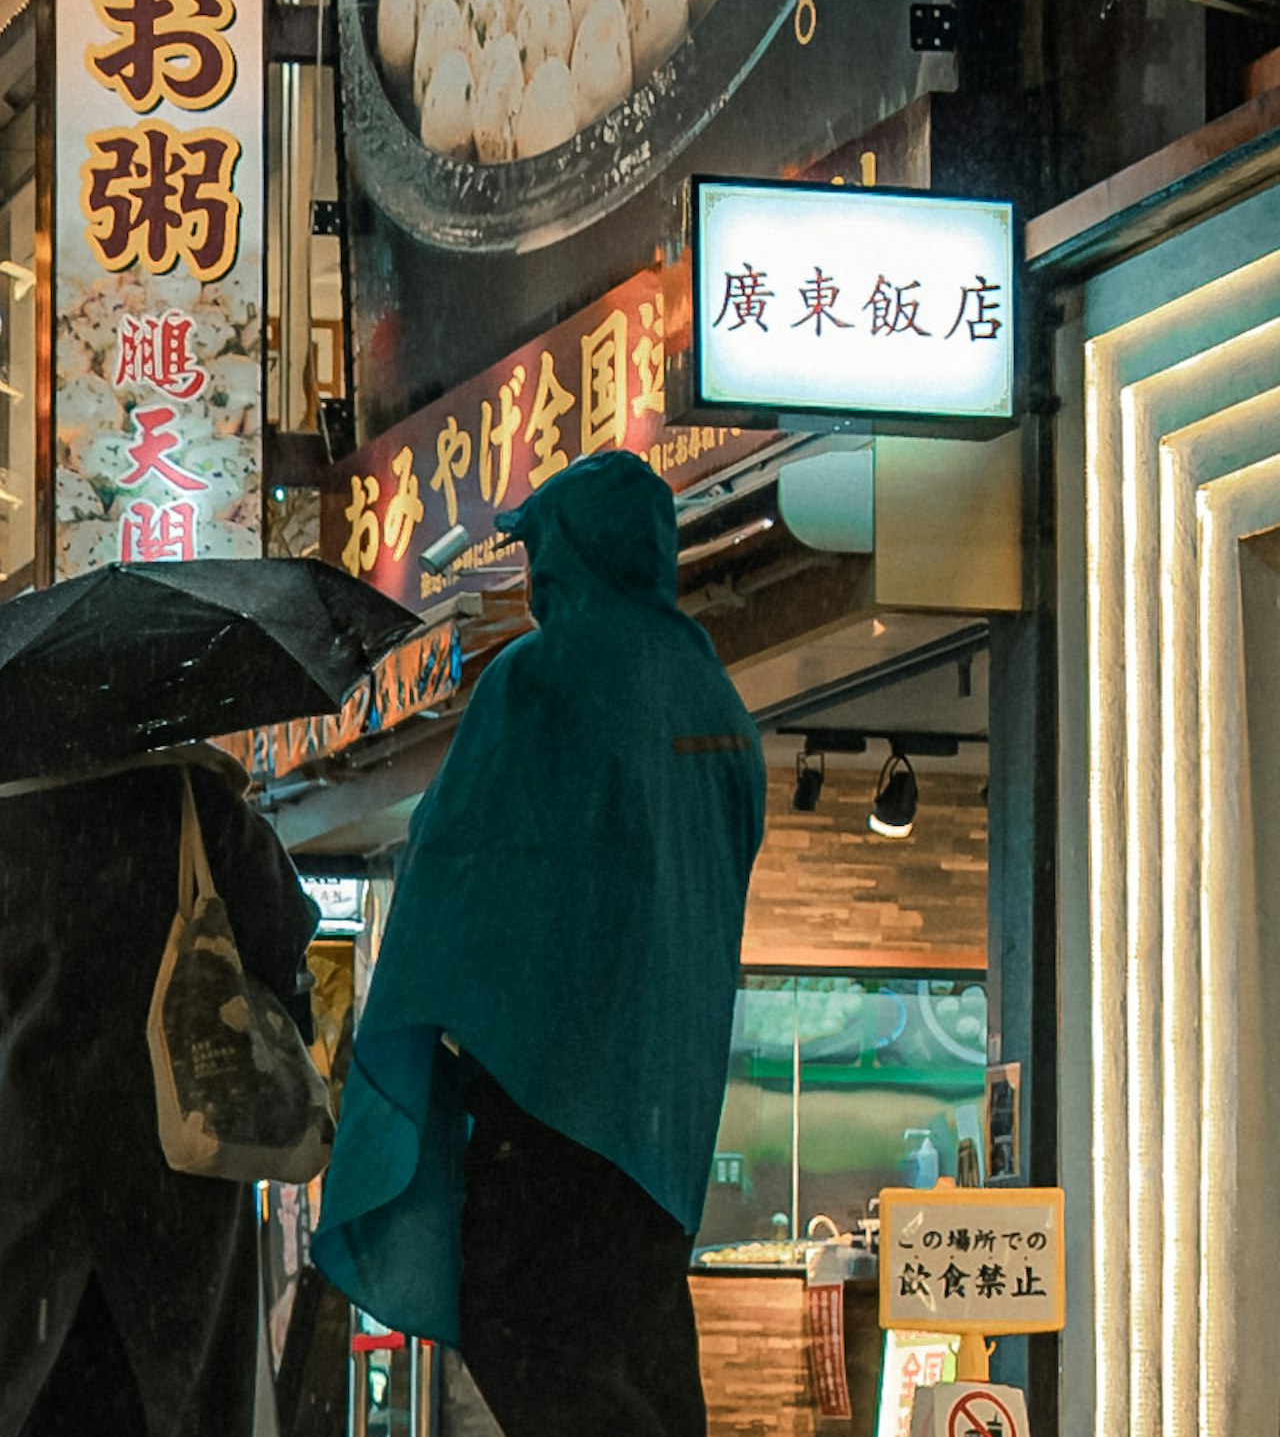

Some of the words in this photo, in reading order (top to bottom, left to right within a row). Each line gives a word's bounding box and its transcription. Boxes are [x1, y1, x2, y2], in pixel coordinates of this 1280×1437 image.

[713, 263, 1003, 342] 廣東飯店
[898, 1229, 1048, 1252] この場所での
[898, 1262, 1048, 1300] 飲食禁止
